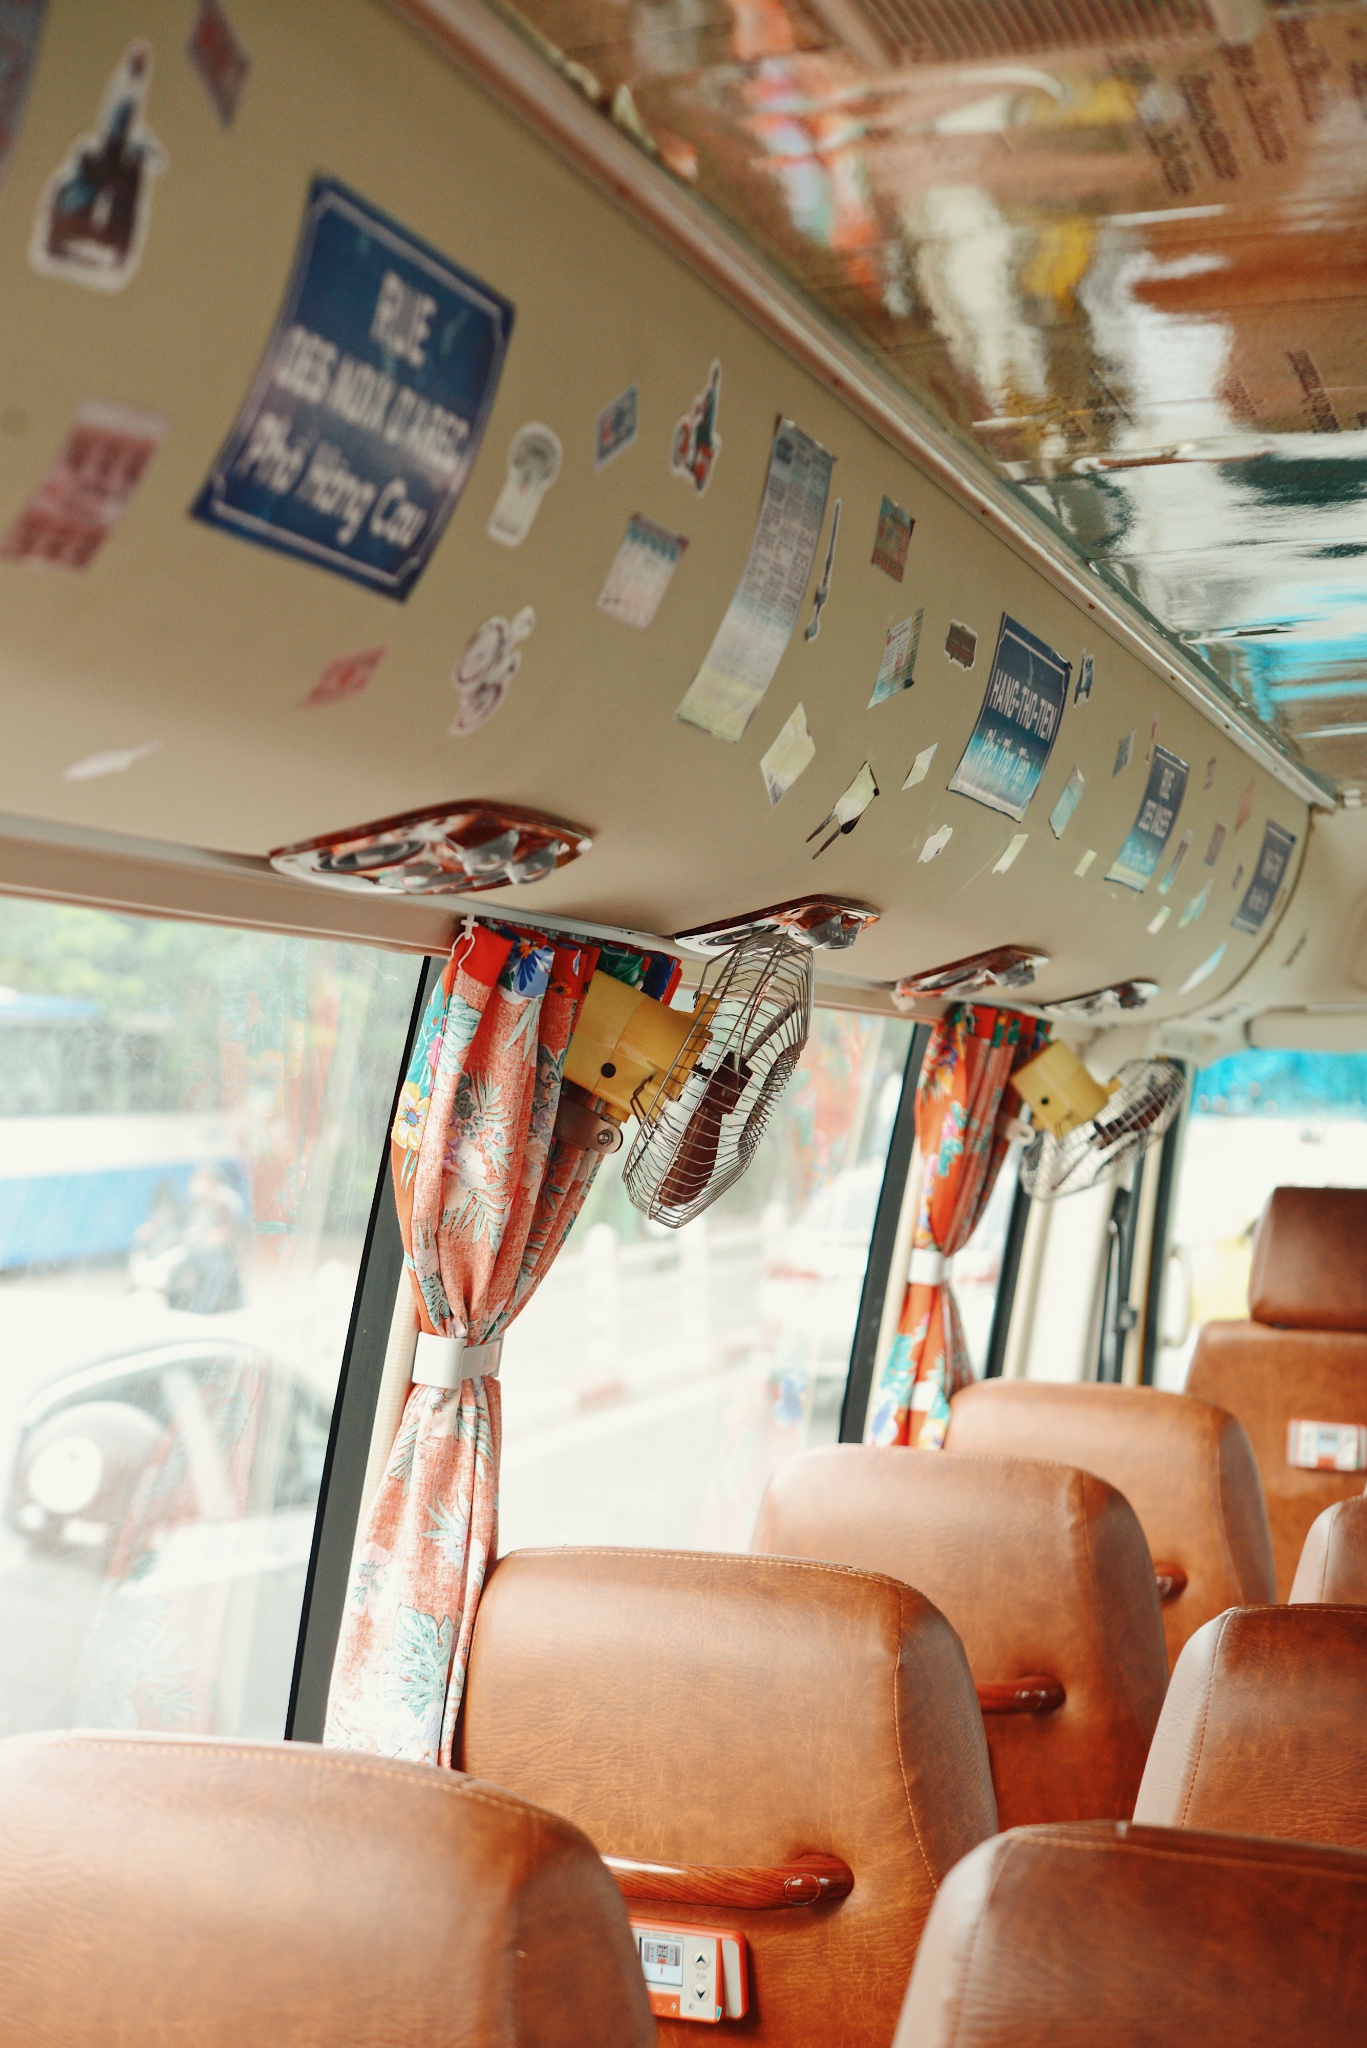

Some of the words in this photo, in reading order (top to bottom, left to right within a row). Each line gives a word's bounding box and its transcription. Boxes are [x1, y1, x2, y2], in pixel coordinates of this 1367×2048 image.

[369, 270, 440, 368] RUE
[274, 324, 342, 406] DES
[988, 667, 1058, 742] HANG-THO-TIEN
